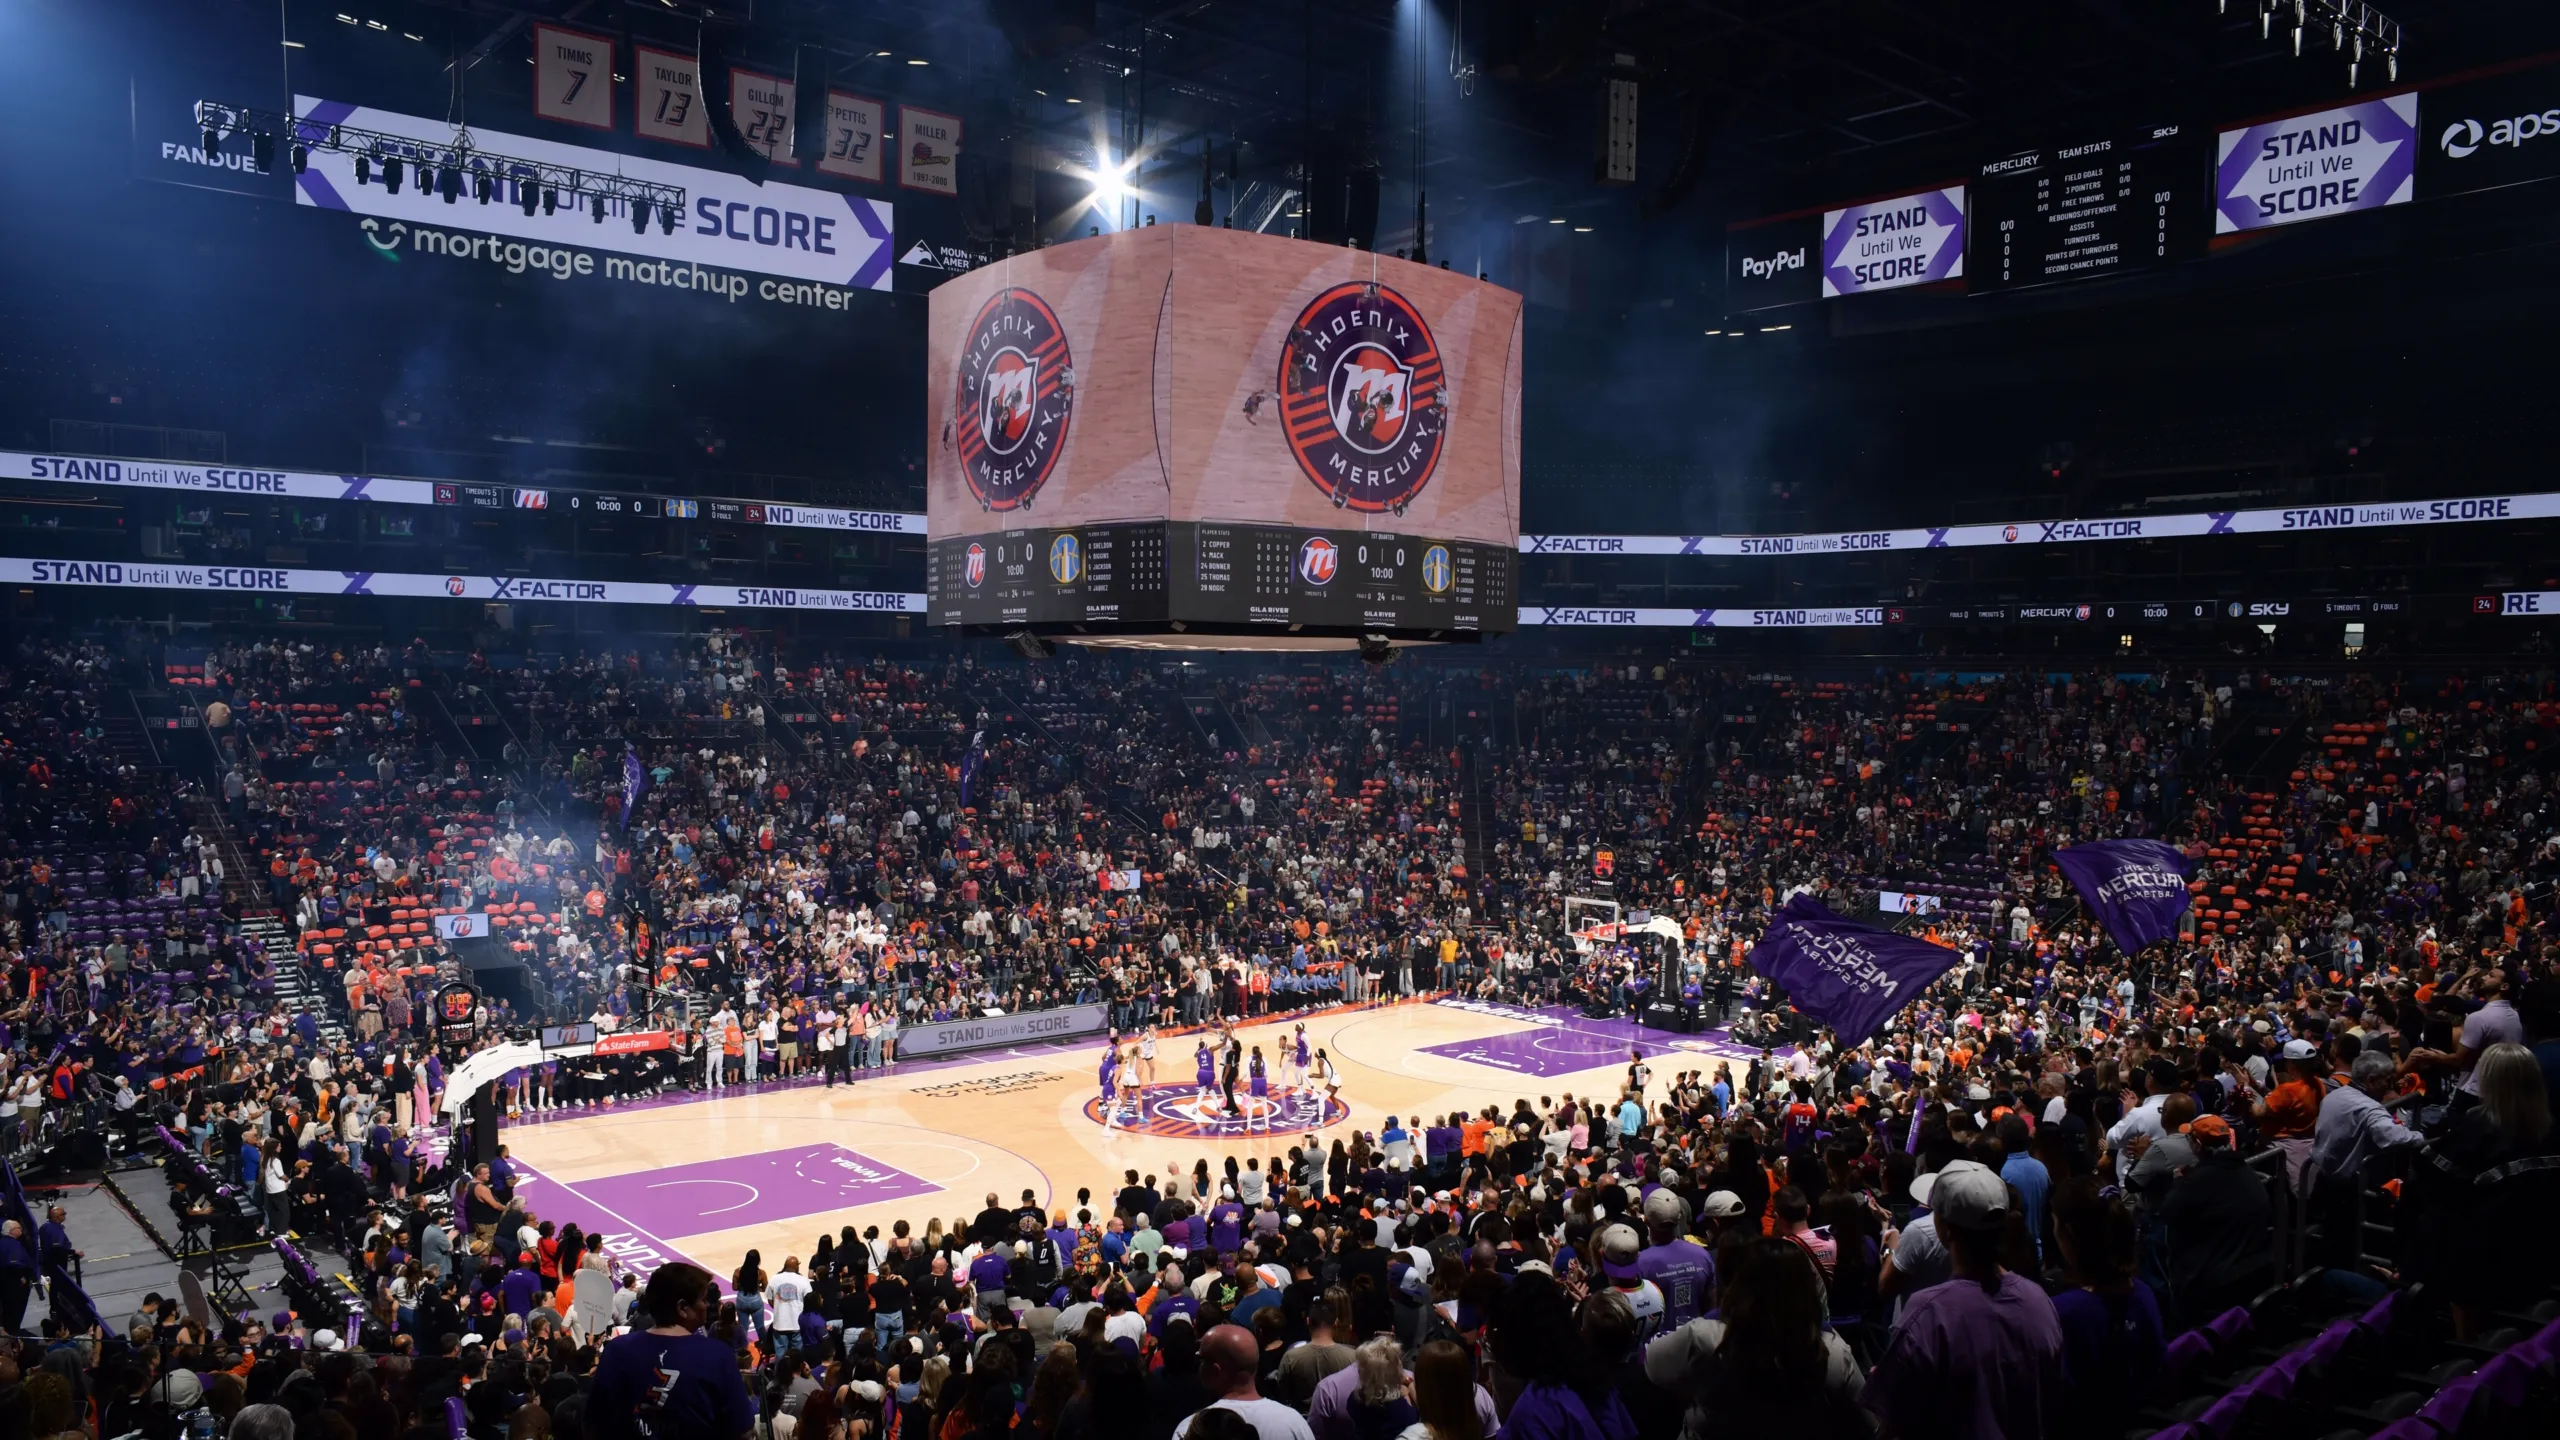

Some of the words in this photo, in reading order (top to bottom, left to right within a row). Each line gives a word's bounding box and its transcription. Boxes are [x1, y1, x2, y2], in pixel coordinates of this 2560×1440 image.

[557, 46, 592, 65] TIMMS
[655, 67, 692, 86] TAYLOR
[561, 69, 587, 104] 7
[654, 88, 692, 126] 13
[748, 89, 784, 107] GILLOM
[836, 108, 866, 124] PETTIS
[743, 109, 787, 146] 22
[916, 124, 946, 140] MILLER
[2153, 126, 2178, 138] SKY
[2489, 110, 2560, 147] aps
[829, 127, 872, 163] 32
[2058, 147, 2082, 159] TEAM
[2084, 141, 2110, 154] STATS
[2262, 120, 2360, 161] STAND
[1983, 155, 2039, 175] MERCURY
[2269, 161, 2312, 184] Until
[2321, 155, 2352, 174] We
[914, 172, 947, 186] 1997-2000
[2065, 173, 2082, 182] FIELD
[2083, 169, 2102, 178] GOALS
[2071, 181, 2100, 192] POINTERS
[2062, 199, 2076, 207] FREE
[2079, 194, 2104, 204] THROWS
[2259, 178, 2360, 218] SCORE
[2001, 220, 2014, 230] 0/0
[2049, 204, 2116, 222] REBOUNDS/OFFENSIVE
[2155, 192, 2170, 203] 0/0
[697, 197, 836, 255] SCORE
[1856, 206, 1927, 237] STAND
[2005, 234, 2010, 242] 0
[2070, 221, 2094, 231] ASSISTS
[2160, 206, 2165, 215] 0
[1862, 239, 1893, 257] Until
[1899, 235, 1921, 250] We
[2005, 246, 2009, 255] 0
[2064, 233, 2100, 245] TURNOVERS
[2159, 219, 2164, 228] 0
[2004, 258, 2009, 267] 0
[2046, 252, 2067, 261] POINTS
[2082, 243, 2118, 255] TURNOVERS
[2159, 232, 2164, 242] 0
[415, 230, 594, 279] mortgage
[606, 258, 748, 302] matchup
[760, 281, 853, 310] center
[1743, 248, 1804, 279] PayPal
[1855, 254, 1927, 285] SCORE
[2004, 271, 2008, 280] 0
[2045, 264, 2068, 274] SECOND
[2070, 260, 2094, 270] CHANCE
[2096, 256, 2118, 265] POINTS
[2158, 246, 2164, 256] 0
[1307, 310, 1410, 372] PHOENIX
[967, 314, 1034, 391] PHOENIX
[980, 410, 1054, 486] MERCURY
[1329, 428, 1428, 486] MERCURY
[32, 458, 120, 482] STAND
[128, 468, 167, 483] Until
[174, 471, 200, 485] We
[206, 470, 286, 492] SCORE
[440, 490, 451, 498] 24
[465, 488, 491, 496] TIMEOUTS
[492, 488, 497, 497] 5
[572, 498, 579, 508] 0
[596, 501, 620, 511] 10:00
[634, 502, 641, 512] 0
[750, 510, 759, 518] 24
[2283, 508, 2354, 528] STAND
[2360, 509, 2394, 522] Until
[2400, 508, 2424, 520] We
[2430, 498, 2510, 520] SCORE
[798, 512, 823, 524] Until
[828, 514, 845, 525] We
[849, 512, 902, 530] SCORE
[2039, 520, 2142, 542] X-FACTOR
[1531, 535, 1624, 552] X-FACTOR
[1741, 538, 1793, 552] STAND
[1797, 540, 1818, 550] Until
[1822, 539, 1837, 549] We
[1841, 533, 1890, 549] SCORE
[998, 546, 1004, 562] 0
[1026, 544, 1032, 560] 0
[1359, 546, 1367, 563] 0
[1397, 549, 1404, 566] 0
[32, 562, 122, 583] STAND
[130, 569, 168, 583] Until
[175, 571, 202, 584] We
[208, 569, 288, 589] SCORE
[1007, 564, 1023, 575] 10:00
[1371, 568, 1393, 578] 10:00
[491, 577, 606, 600] X-FACTOR
[1377, 592, 1385, 601] 24
[738, 589, 796, 606] STAND
[801, 594, 826, 605] Until
[831, 595, 848, 606] We
[852, 593, 905, 609] SCORE
[2327, 604, 2331, 612] 5
[2478, 600, 2490, 609] 24
[1542, 608, 1635, 624] X-FACTOR
[1754, 611, 1806, 624] STAND
[1810, 613, 1832, 623] Until
[1836, 612, 1851, 622] We
[1891, 612, 1899, 620] 24
[2021, 608, 2072, 618] MERCURY
[2108, 608, 2114, 617] 0
[2144, 609, 2167, 617] 10:00
[2195, 606, 2202, 616] 0
[2249, 604, 2289, 615] SKY
[938, 1027, 984, 1045] STAND
[987, 1027, 1008, 1037] Until
[1010, 1025, 1026, 1035] We
[1028, 1016, 1070, 1034] SCORE
[909, 1070, 1047, 1094] mortgage
[964, 1075, 1064, 1094] matchup
[985, 1084, 1039, 1096] center
[1796, 1115, 1810, 1126] 14
